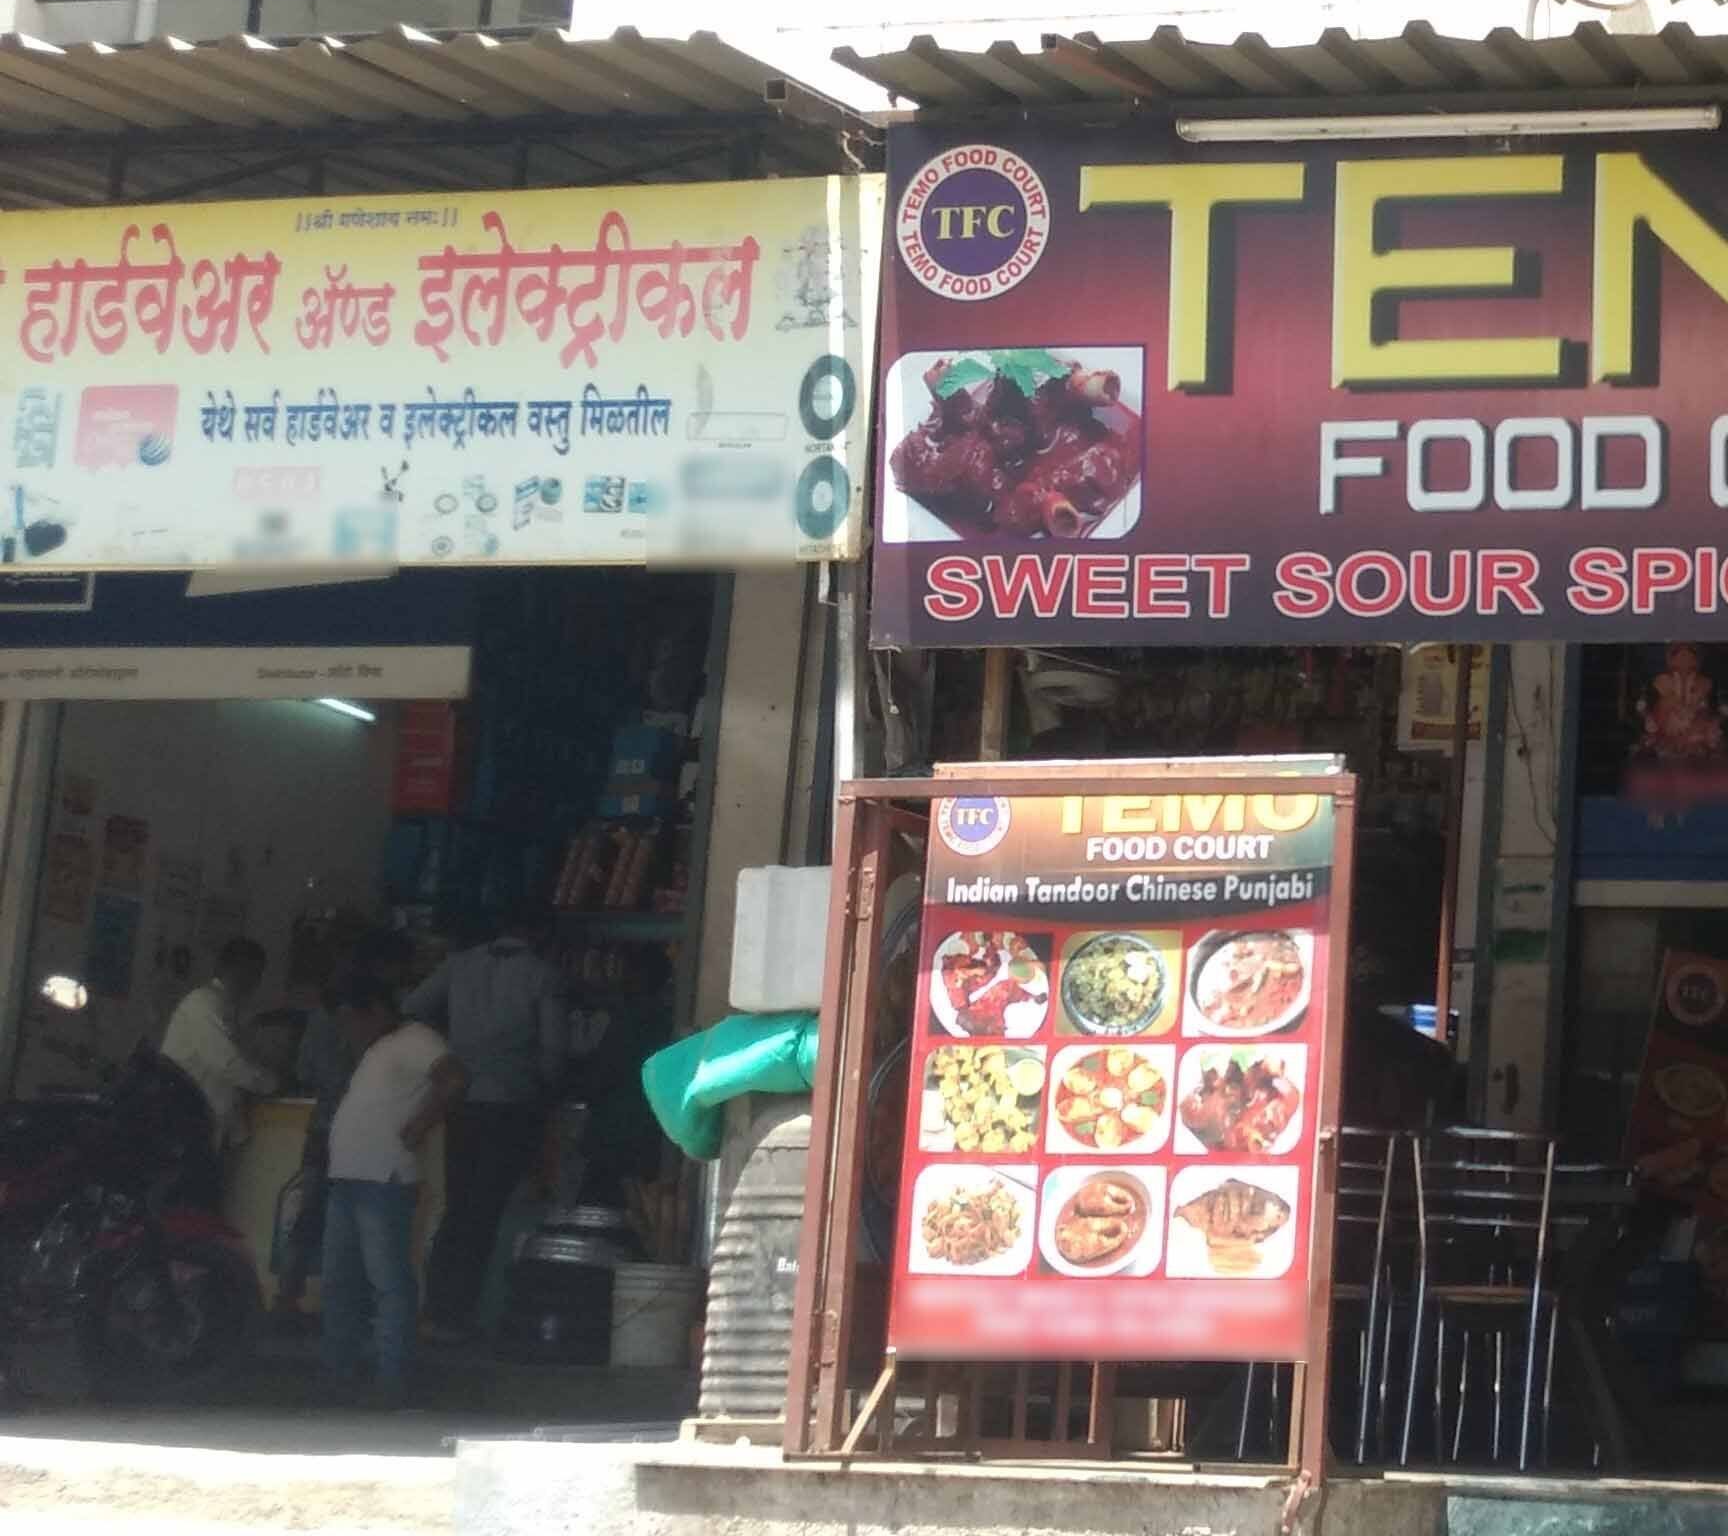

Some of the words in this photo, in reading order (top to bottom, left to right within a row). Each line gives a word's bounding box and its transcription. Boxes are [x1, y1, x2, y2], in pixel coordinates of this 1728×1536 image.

[903, 169, 939, 224] TEMO
[942, 149, 998, 173] FOOD
[1002, 157, 1046, 219] COURT
[931, 205, 1015, 240] TFC
[903, 230, 938, 281] TEMO
[938, 273, 992, 295] FOOD
[996, 226, 1043, 286] COURT
[20, 223, 283, 364] हार्डवेअर
[200, 390, 235, 442] येथे
[244, 389, 281, 442] सर्व
[379, 402, 397, 440] व
[1320, 414, 1664, 515] FOOD
[923, 553, 1250, 622] SWEET
[1273, 550, 1545, 617] SOUR
[957, 807, 994, 825] TFC
[1086, 835, 1168, 862] FOOD
[1173, 833, 1275, 860] COURT
[947, 875, 1018, 903] Indian
[1025, 875, 1119, 904] Tandoor
[1125, 873, 1217, 902] Chinese
[1223, 872, 1314, 907] Punjabi
